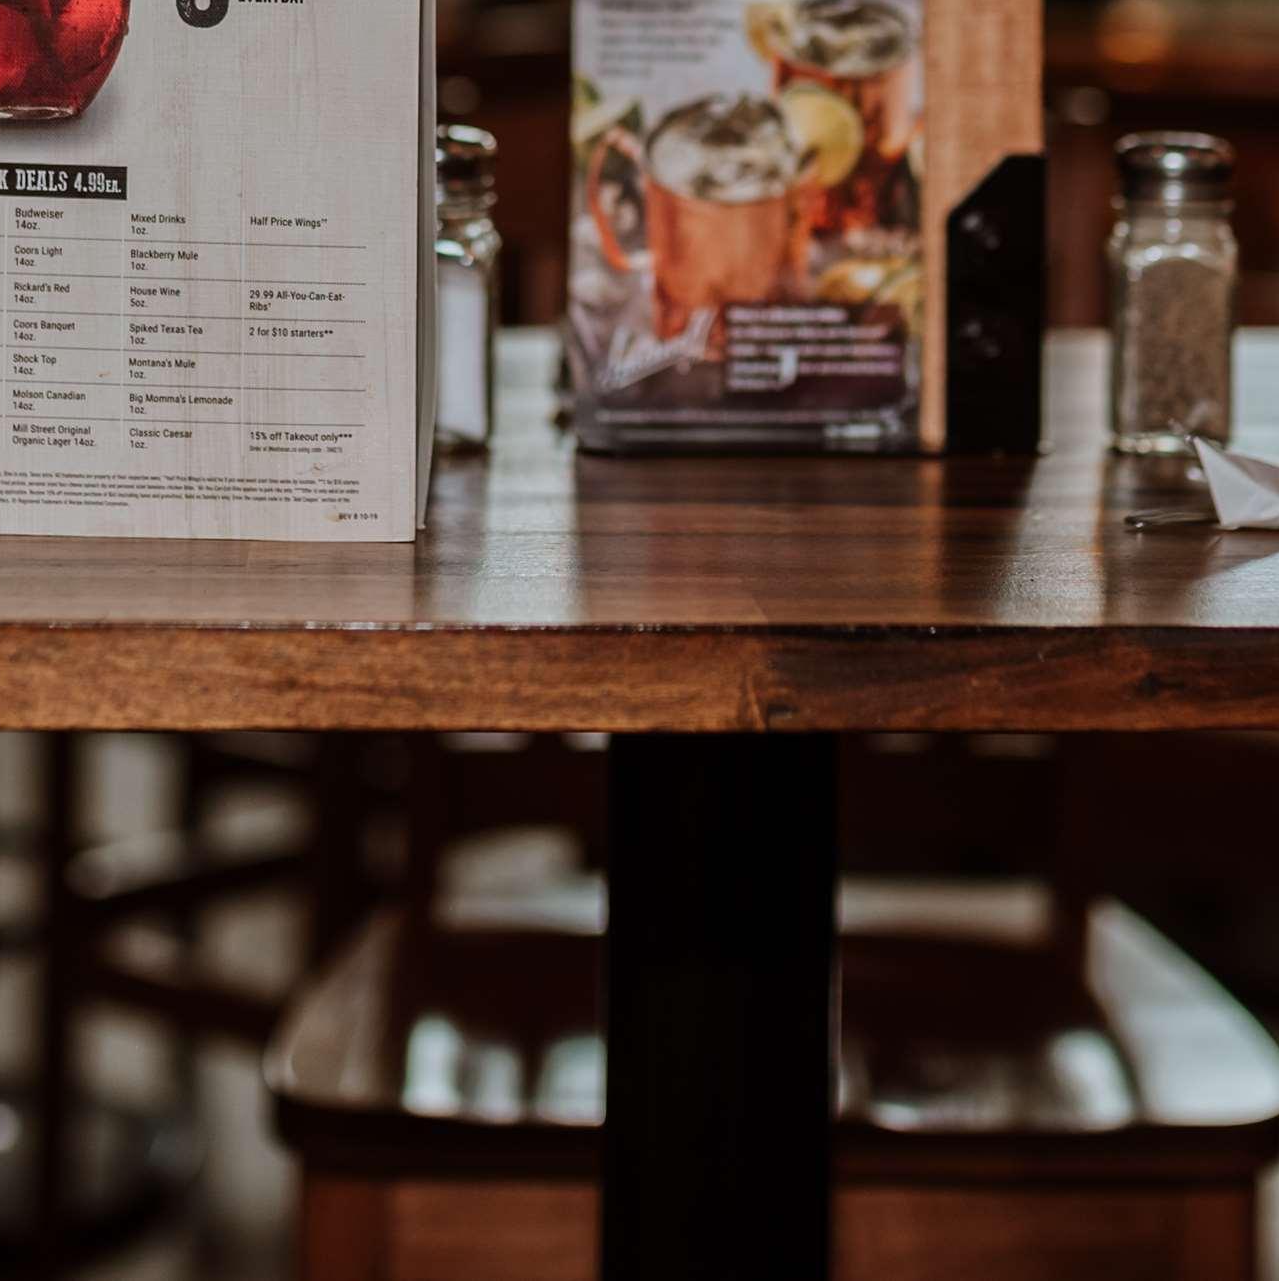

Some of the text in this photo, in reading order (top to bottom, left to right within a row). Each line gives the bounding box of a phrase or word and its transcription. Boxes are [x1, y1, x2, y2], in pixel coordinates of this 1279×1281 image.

[15, 169, 68, 192] DEALS
[15, 207, 64, 219] Budweiser
[130, 214, 186, 224] Mixed Drinks
[250, 216, 268, 226] Half
[270, 217, 293, 227] Price
[15, 220, 40, 230] 14oz.
[14, 245, 63, 258] Coors Light
[130, 249, 199, 261] Blackberry Mule
[14, 282, 70, 293] Rickard's Red
[130, 286, 181, 296] House Wine
[13, 319, 75, 331] Coors Banquet
[129, 323, 203, 334] Spiked Texas Tea
[249, 326, 255, 336] 2
[257, 327, 270, 337] for
[272, 327, 288, 338] $10
[13, 353, 57, 365] Shock Top
[128, 358, 196, 368] Montana's Mule
[13, 389, 86, 401] Molson Canadian
[129, 394, 233, 405] Big Momma's Lemonade
[12, 423, 91, 436] Mill Street Original
[129, 428, 192, 438] Classic Caesar
[12, 435, 45, 446] Organic
[47, 437, 71, 448] Lager
[250, 431, 268, 441] 15%
[269, 431, 282, 441] off
[284, 432, 319, 442] Takeout
